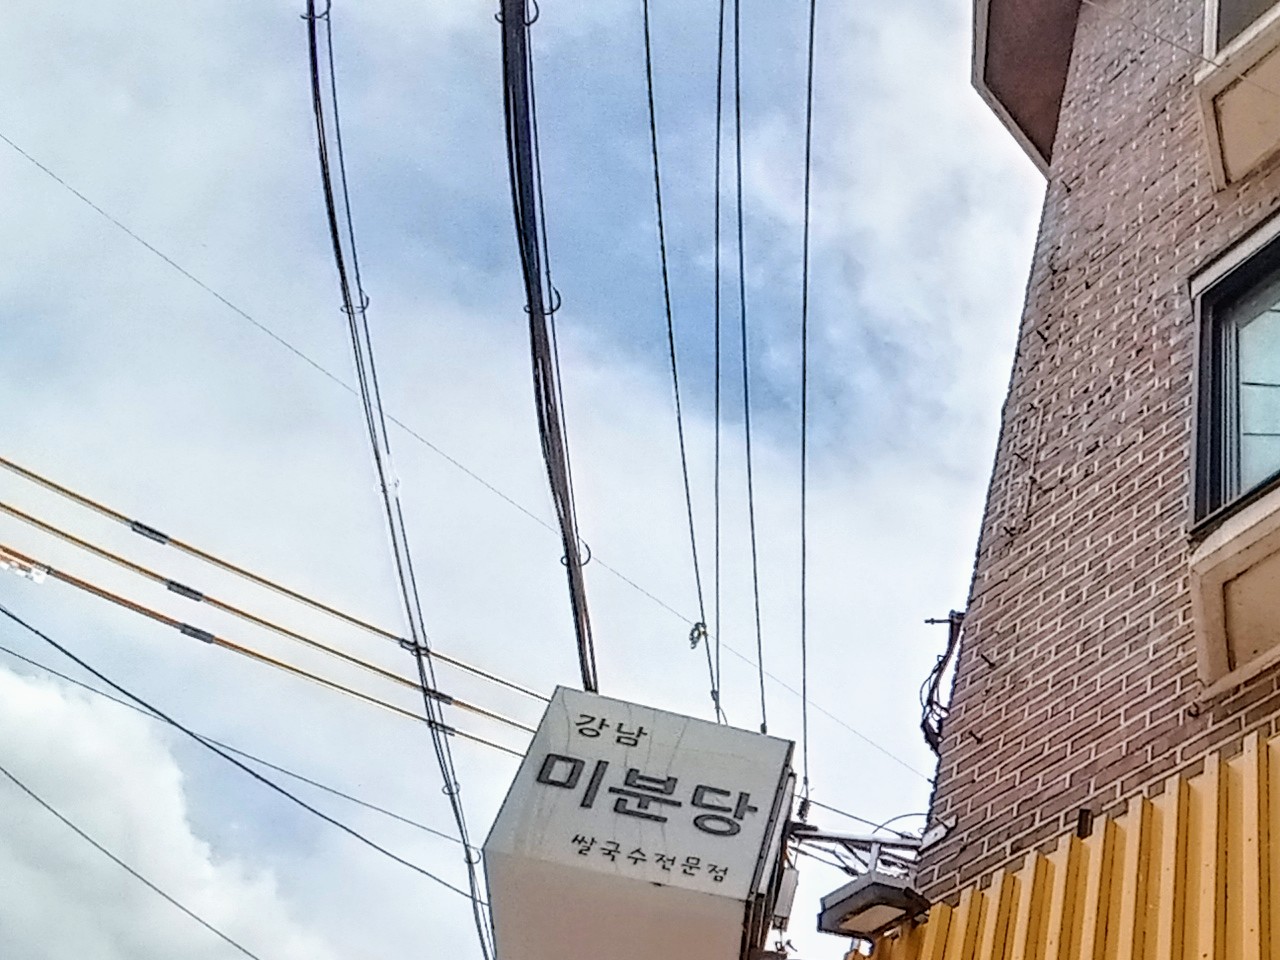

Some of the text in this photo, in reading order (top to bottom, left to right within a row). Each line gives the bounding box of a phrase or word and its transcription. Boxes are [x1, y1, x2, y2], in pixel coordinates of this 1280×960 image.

[574, 714, 648, 747] 강남
[536, 753, 758, 836] 미분당
[571, 834, 729, 883] 쌀국수전문점
